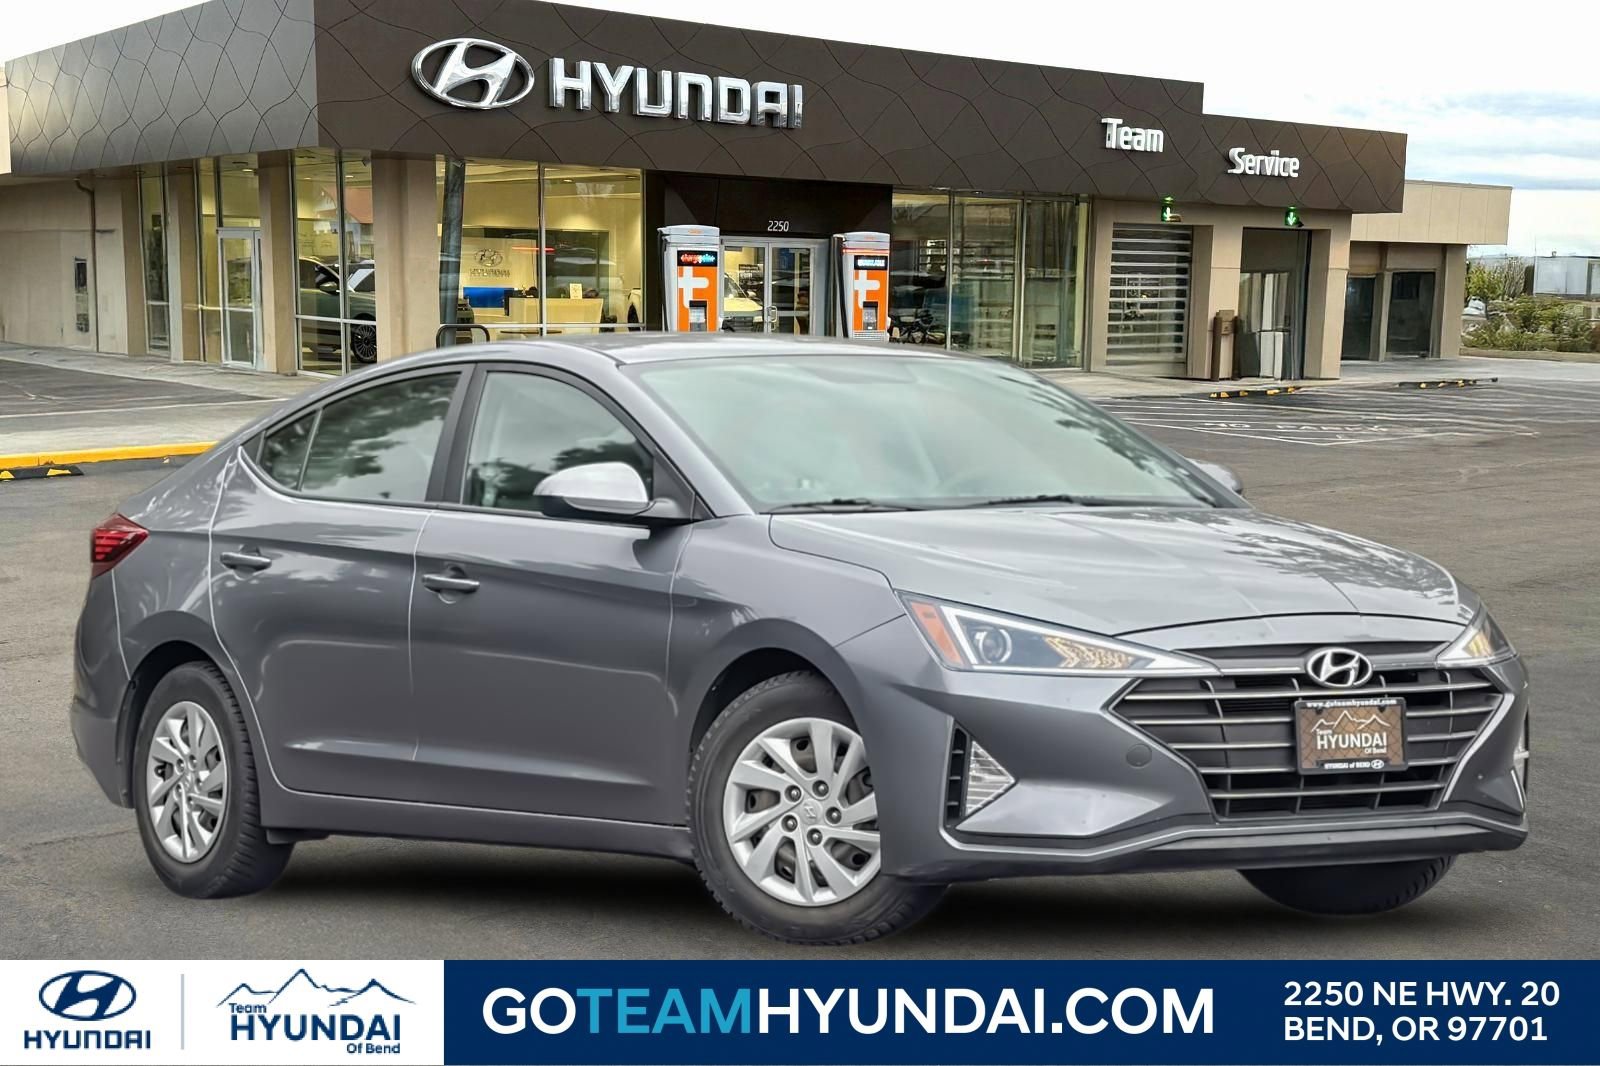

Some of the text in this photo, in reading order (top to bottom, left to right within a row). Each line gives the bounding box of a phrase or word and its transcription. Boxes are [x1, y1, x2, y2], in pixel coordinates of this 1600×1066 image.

[549, 57, 803, 129] HYUNDAI
[1101, 117, 1164, 153] Team
[1227, 147, 1300, 178] Service
[767, 220, 789, 232] 2250
[1317, 733, 1387, 750] HYUNDAI
